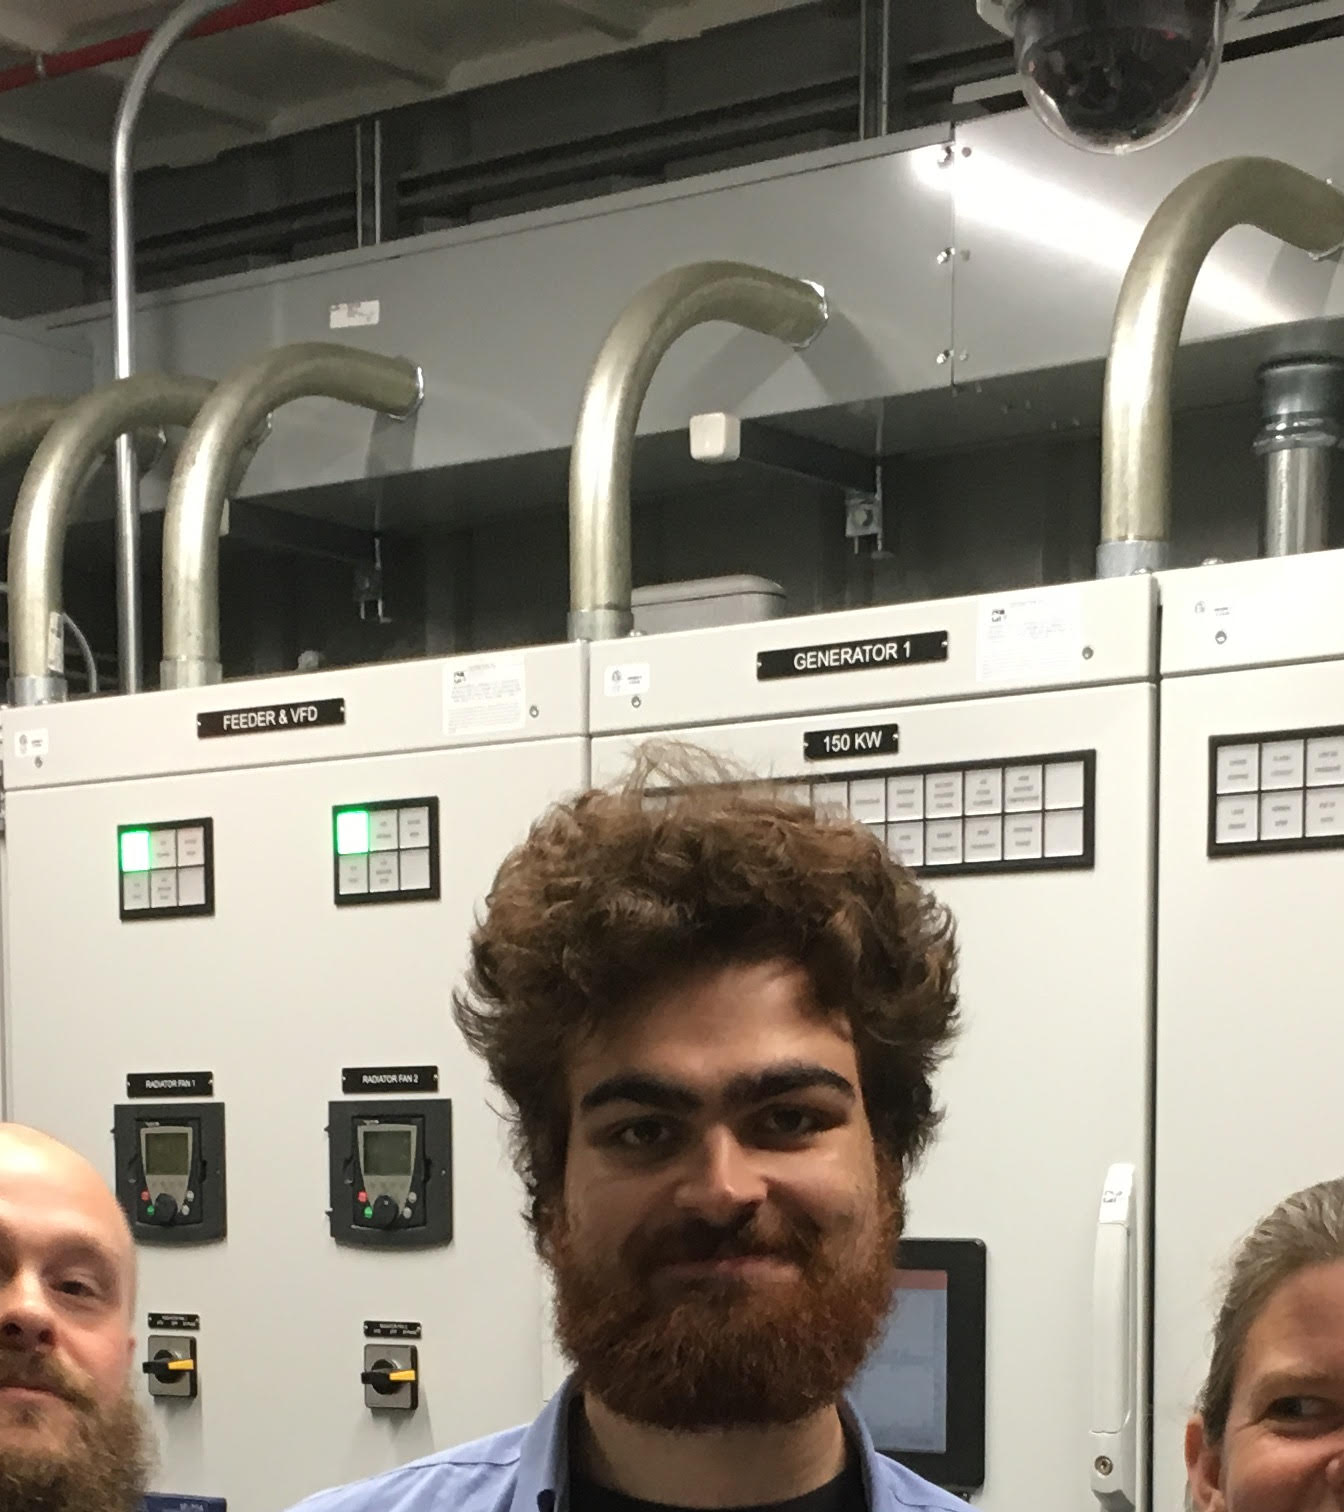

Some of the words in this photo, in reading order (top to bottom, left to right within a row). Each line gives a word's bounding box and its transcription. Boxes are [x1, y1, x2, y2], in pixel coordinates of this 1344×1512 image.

[793, 642, 899, 671] GENERATOR
[902, 640, 912, 658] 1
[223, 710, 276, 731] FEEDER
[278, 708, 288, 725] &
[289, 705, 318, 724] VFD
[822, 733, 851, 753] 150
[854, 730, 883, 750] KW
[145, 1080, 177, 1089] RADIATOR
[177, 1079, 191, 1088] FAN
[362, 1074, 398, 1084] RADIATOR
[398, 1073, 413, 1083] FAN
[413, 1074, 419, 1083] 2
